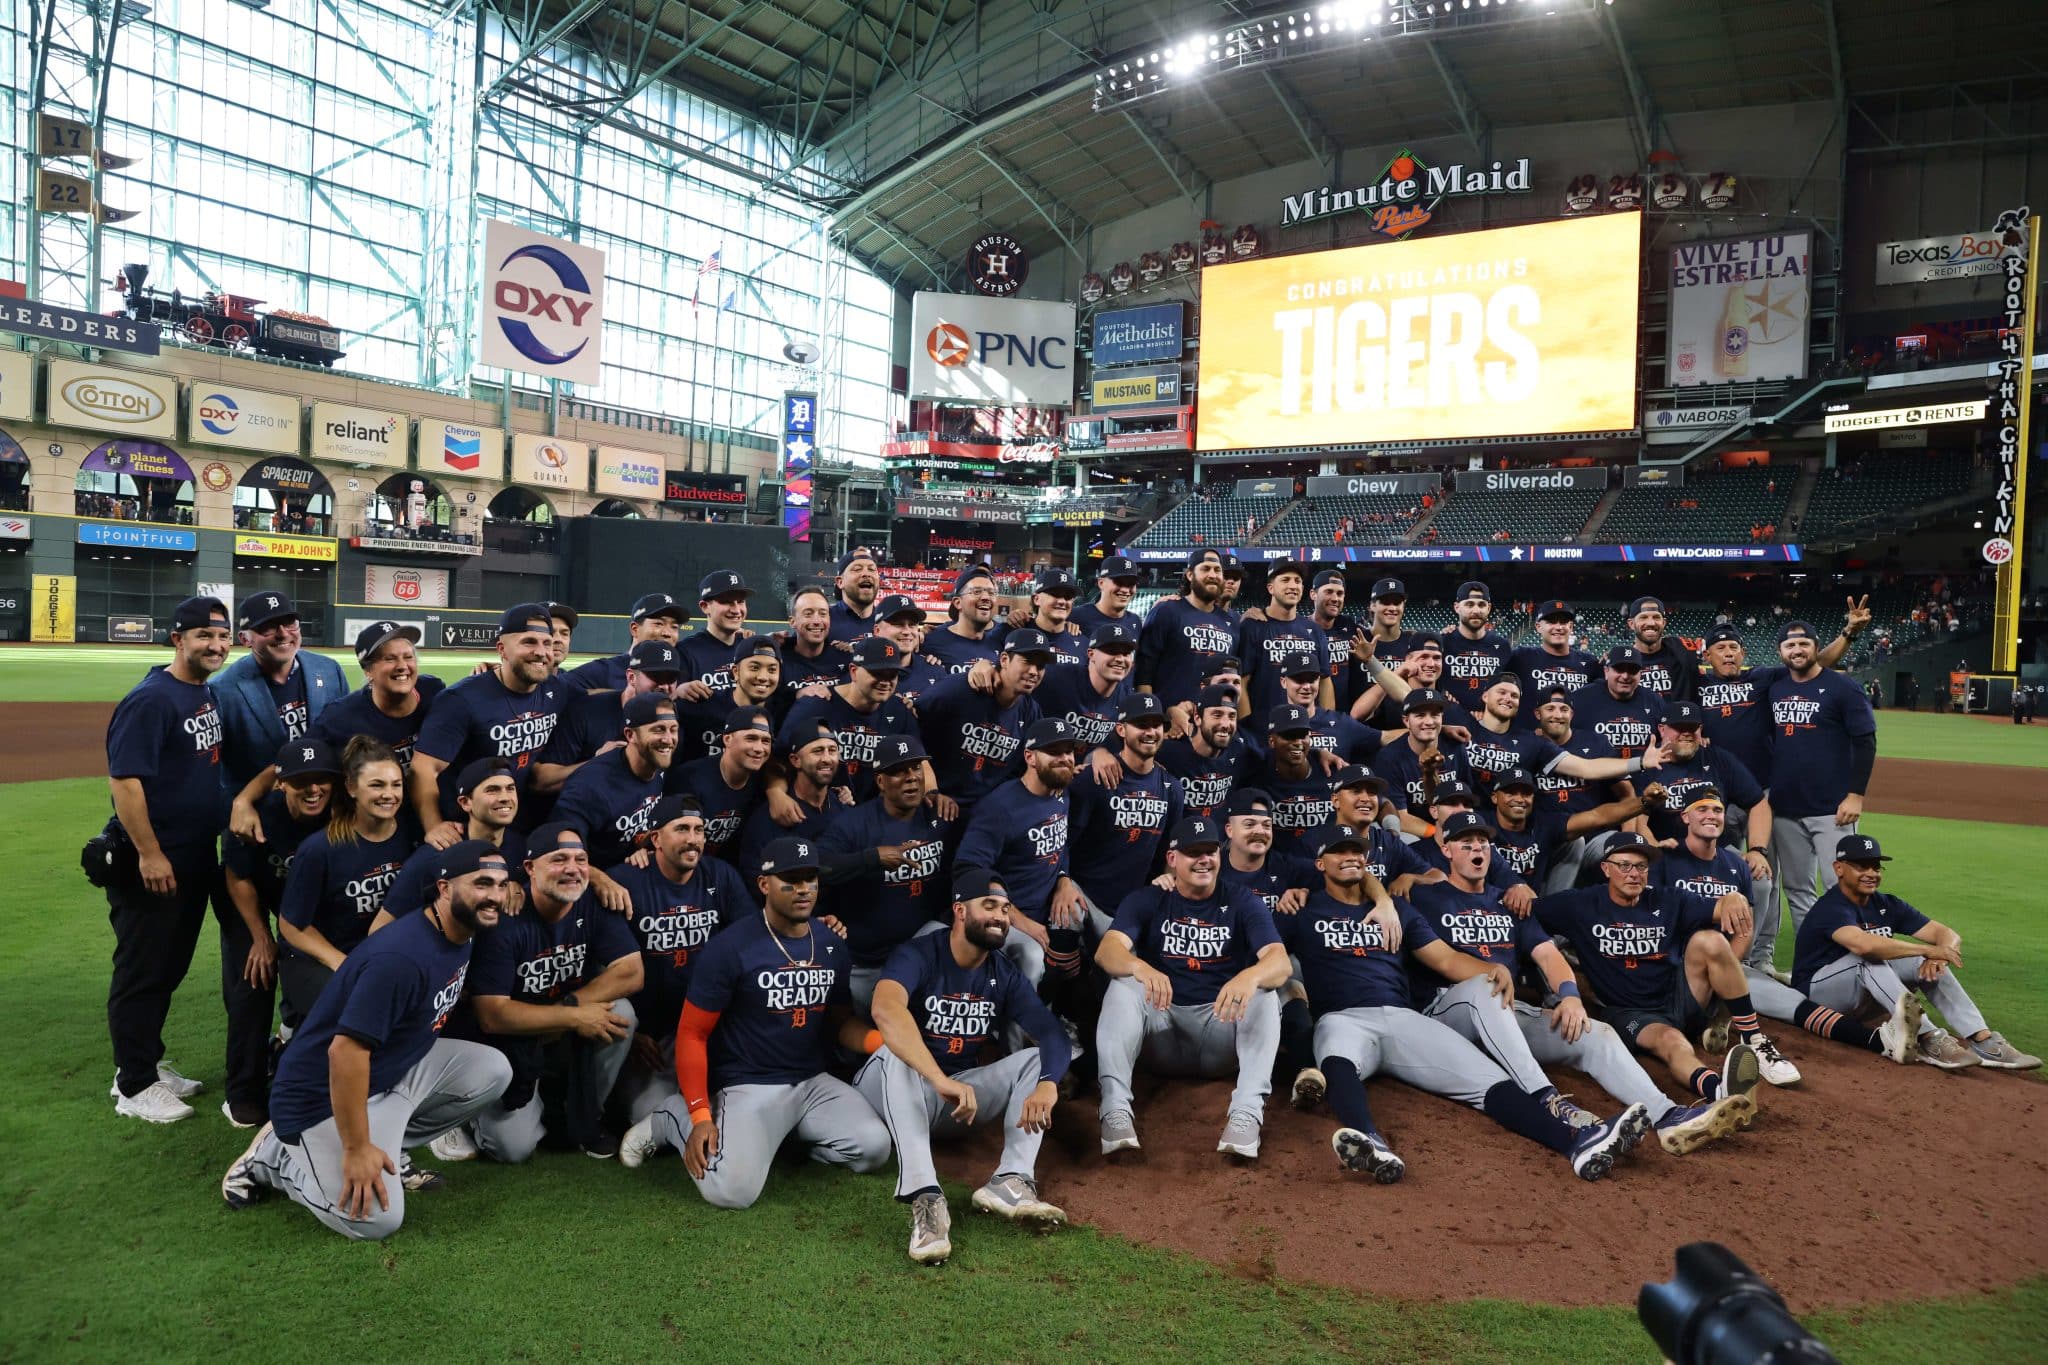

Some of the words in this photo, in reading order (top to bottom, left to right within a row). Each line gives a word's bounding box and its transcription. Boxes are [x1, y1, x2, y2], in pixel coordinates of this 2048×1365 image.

[52, 126, 82, 148] 17
[1281, 176, 1417, 226] Minute
[1425, 158, 1531, 197] Maid
[1609, 173, 1640, 195] 24
[1662, 173, 1678, 194] 5
[1710, 172, 1726, 195] 7
[50, 183, 79, 203] 22
[1372, 204, 1431, 236] Park
[975, 236, 1021, 256] HOUSTON
[1752, 236, 1784, 258] TU
[1886, 244, 1951, 265] Texas
[1961, 236, 2006, 260] Bay
[987, 254, 1009, 275] H
[1927, 266, 1962, 278] CREDIT
[975, 276, 1018, 292] ASTROS
[1287, 256, 1529, 302] CONGRATULATIONS
[495, 280, 593, 326] OXY
[0, 304, 137, 343] LEADERS
[1100, 322, 1175, 345] Methodist
[975, 331, 1067, 370] PNC
[1273, 284, 1543, 417] TIGERS
[1104, 384, 1151, 398] MUSTANG
[1157, 380, 1176, 394] CAT
[76, 384, 150, 416] COTTON
[200, 407, 240, 422] OXY
[247, 413, 274, 427] ZERO
[1676, 410, 1737, 424] NABORS
[1831, 414, 1902, 428] DOGGETT
[1925, 406, 1974, 421] RENTS
[326, 420, 389, 444] reliant
[445, 424, 481, 438] Chevron
[129, 451, 168, 466] planet
[915, 459, 960, 469] HORNITOS
[134, 461, 175, 475] fitness
[262, 466, 292, 481] SPACE
[292, 470, 314, 483] CITY
[534, 471, 569, 484] QUANTA
[1347, 478, 1398, 495] Chevy
[1486, 472, 1574, 490] Silverado
[667, 485, 747, 502] Budweiser
[908, 504, 958, 517] impact
[974, 508, 1022, 521] impact
[1052, 511, 1105, 520] PLUCKERS
[96, 530, 183, 545] 1POINTFIVE
[373, 540, 409, 548] PROVIDING
[930, 534, 995, 549] Budweiser
[271, 542, 295, 554] PAPA
[297, 545, 332, 557] JOHN'S
[1263, 550, 1292, 559] DETROIT
[1544, 548, 1583, 559] HOUSTON
[397, 573, 418, 581] PHILLIPS
[892, 568, 943, 579] Budweiser
[398, 584, 415, 595] 66
[49, 578, 59, 634] DOGGETT
[459, 629, 500, 638] VERITE
[1183, 626, 1233, 647] OCTOBER
[1190, 637, 1231, 655] READY
[1263, 639, 1316, 652] OCTOBER
[1445, 655, 1500, 667] OCTOBER
[1450, 666, 1496, 678] READY
[1531, 669, 1589, 684] OCTOBER
[1698, 682, 1754, 697] OCTOBER
[1701, 690, 1753, 707] READY
[1772, 700, 1820, 713] OCTOBER
[1065, 711, 1116, 733] OCTOBER
[1774, 711, 1813, 725] READY
[489, 715, 557, 741] OCTOBER
[961, 722, 1021, 750] OCTOBER
[1594, 722, 1651, 735] OCTOBER
[497, 727, 553, 757] READY
[961, 738, 1013, 763] READY
[838, 745, 875, 763] READ
[1181, 775, 1232, 794] OCTOBER
[1109, 796, 1168, 813] OCTOBER
[1183, 789, 1230, 807] READY
[1114, 810, 1164, 828] READY
[1275, 811, 1330, 828] READY
[345, 866, 401, 897] OCTO
[1675, 878, 1738, 897] OCTOBER
[639, 909, 719, 933] OCTOBER
[1314, 920, 1382, 935] OCTOBE
[1441, 912, 1514, 928] OCTOBER
[646, 926, 713, 951] READY
[1160, 919, 1231, 940] OCTOBER
[1450, 927, 1511, 943] READY
[1592, 924, 1666, 941] OCTOBER
[1162, 935, 1225, 957] READY
[1599, 938, 1661, 956] READY
[523, 960, 585, 993] READY
[757, 969, 836, 989] OCTOBER
[766, 986, 831, 1010] READY
[925, 995, 997, 1018] OCTOBER
[925, 1013, 990, 1036] READY
